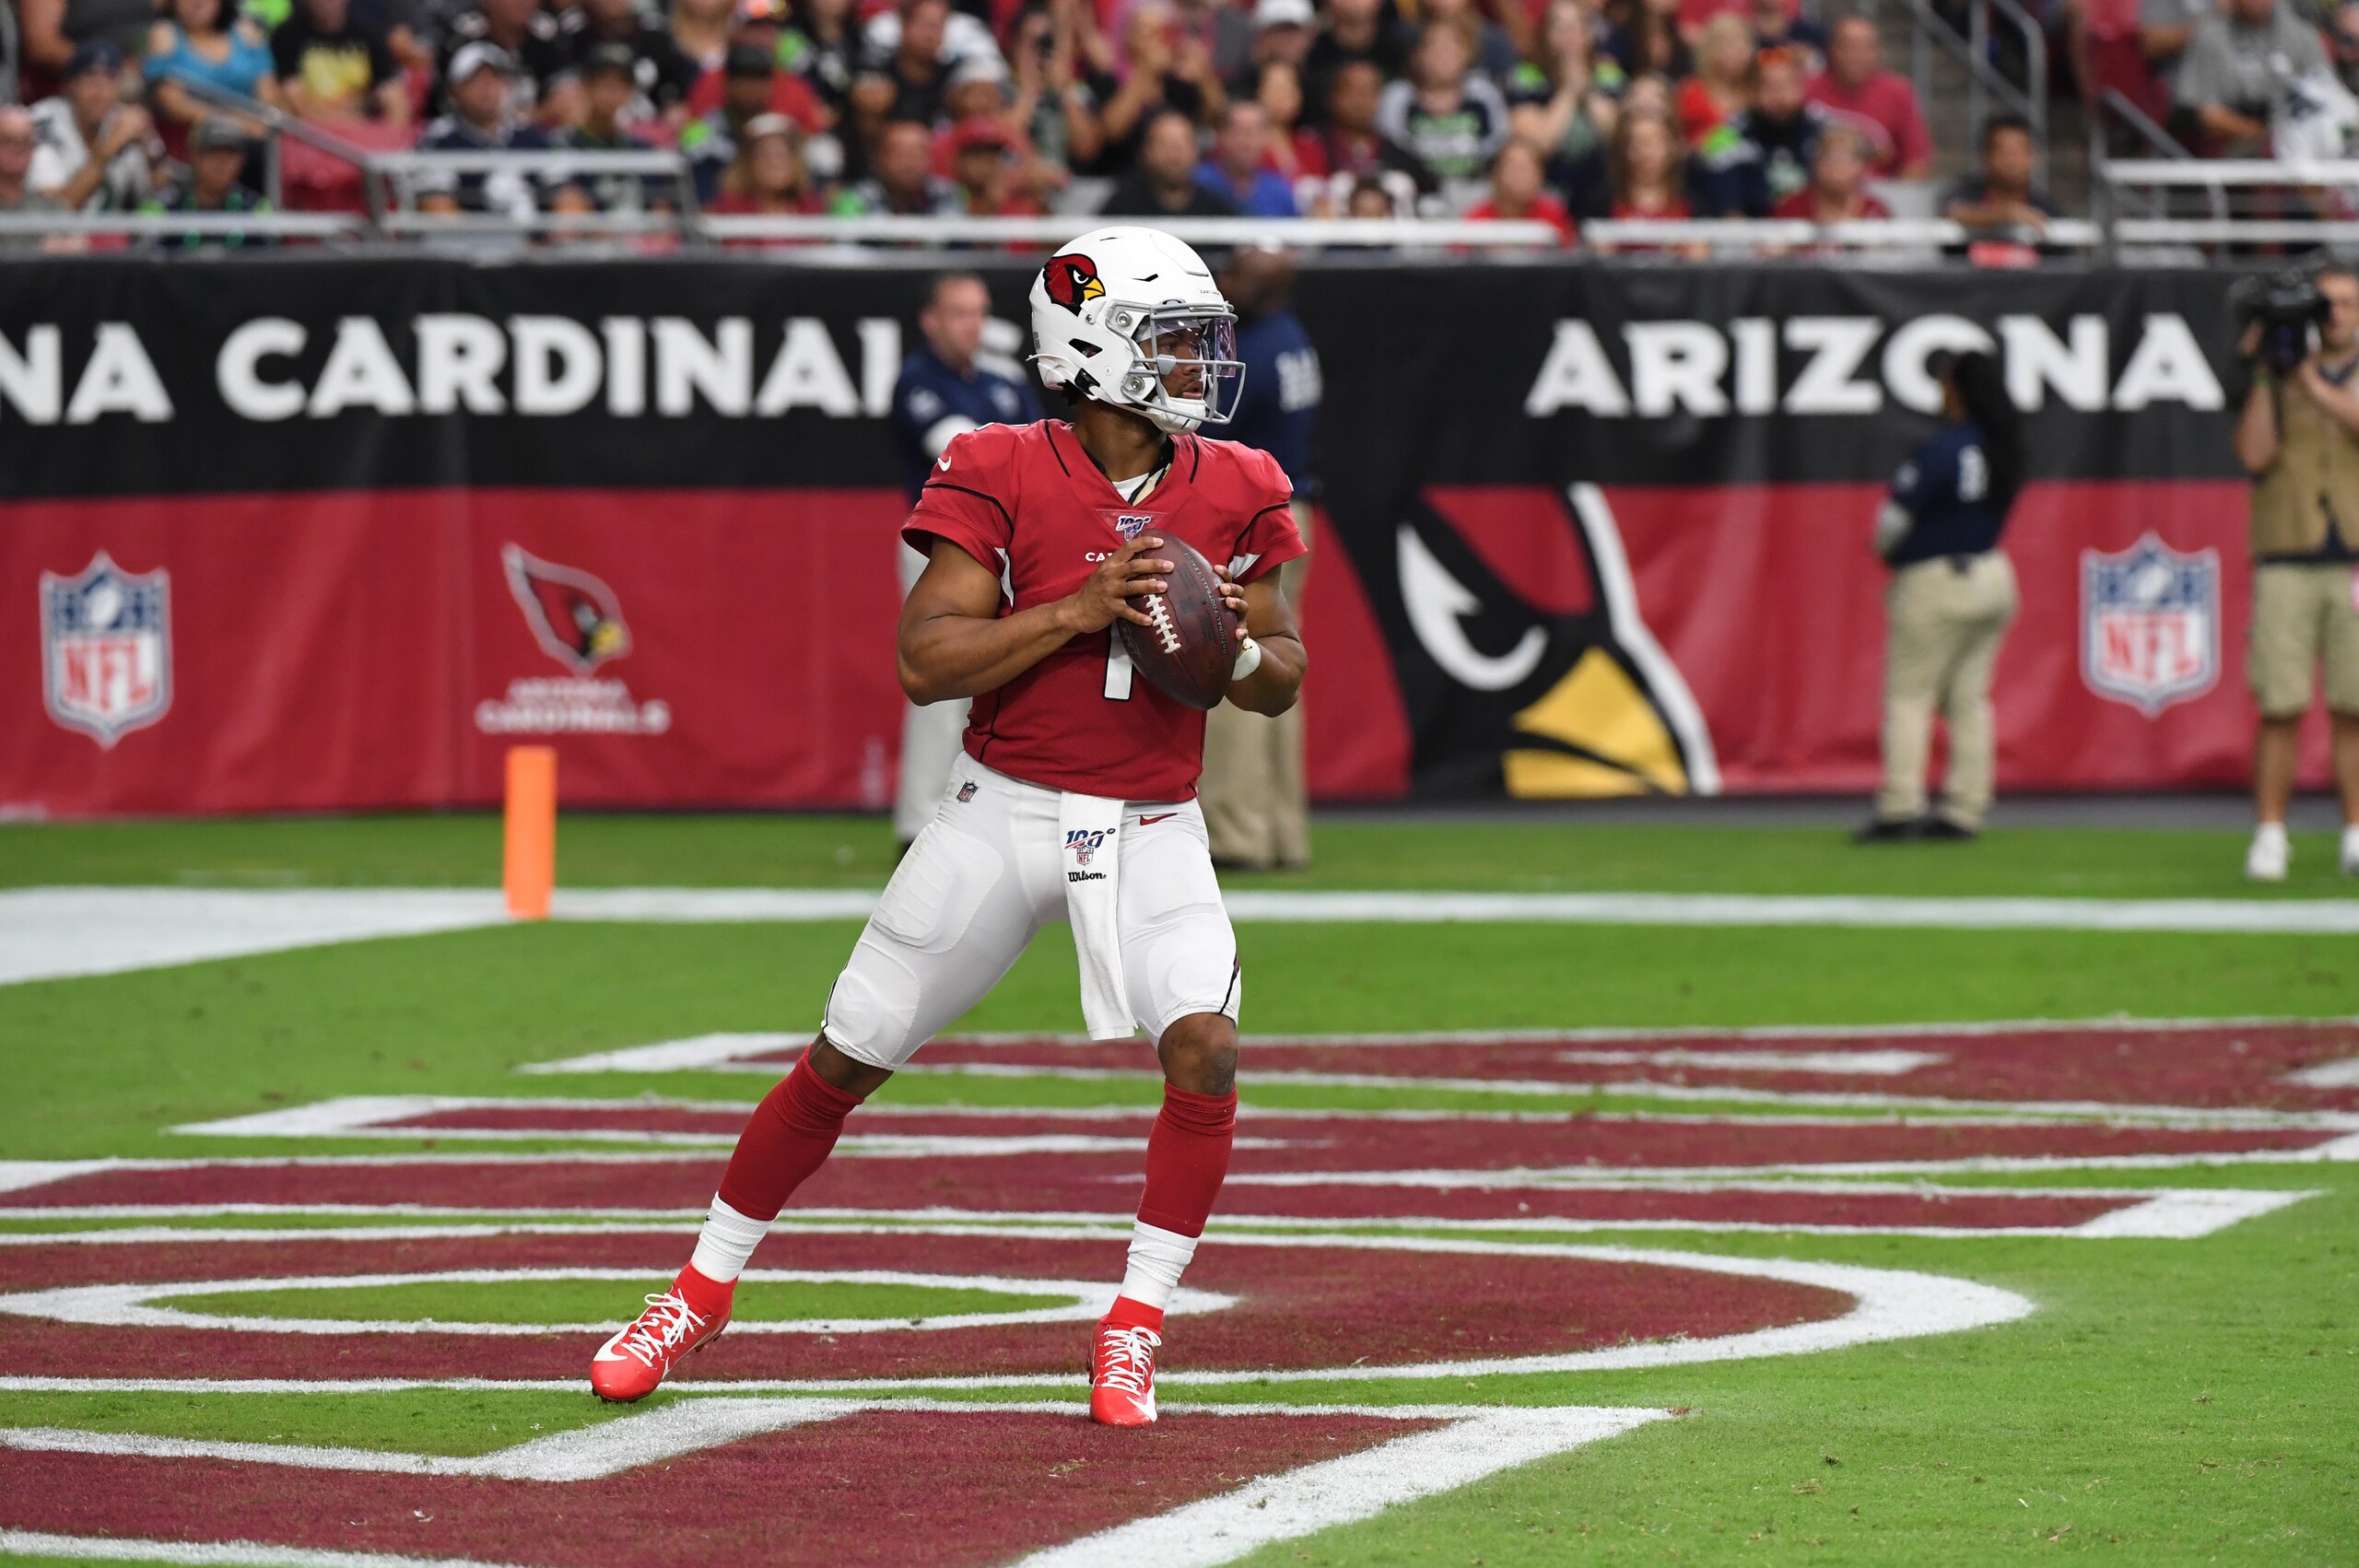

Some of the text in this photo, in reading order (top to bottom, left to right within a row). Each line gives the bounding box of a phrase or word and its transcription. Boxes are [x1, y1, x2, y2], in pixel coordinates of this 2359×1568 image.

[2100, 612, 2201, 684] NFL
[62, 638, 155, 715] NFL
[1067, 870, 1103, 883] Wilson
[1078, 853, 1091, 864] NFL
